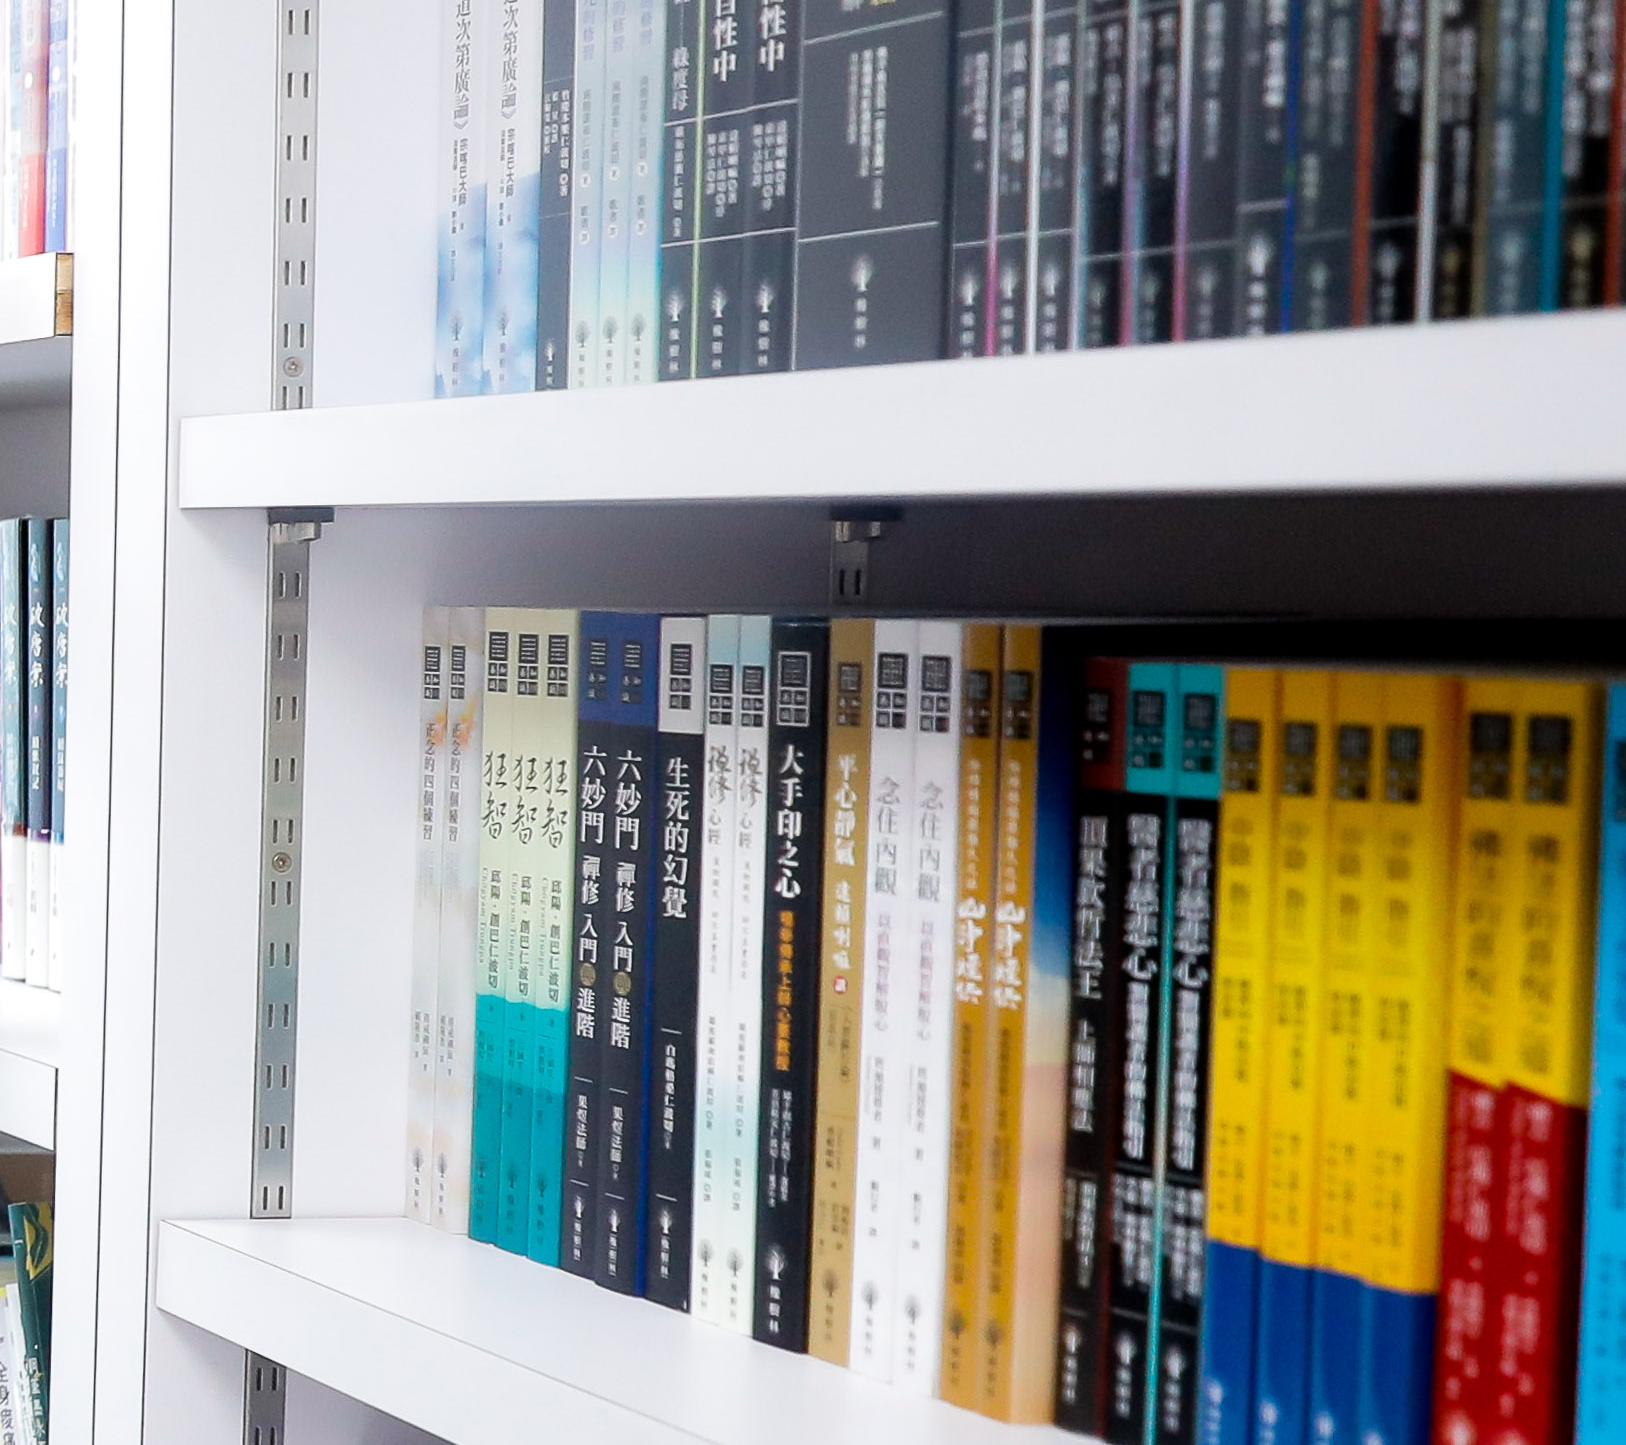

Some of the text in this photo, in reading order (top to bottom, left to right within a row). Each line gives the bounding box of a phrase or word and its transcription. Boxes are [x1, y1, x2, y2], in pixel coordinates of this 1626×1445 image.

[481, 749, 509, 841] 狂智
[511, 753, 539, 846] 狂智
[541, 755, 570, 849] 狂智
[578, 744, 609, 845] 六妙門
[613, 749, 643, 852] 六妙門
[661, 756, 691, 920] 生死的幻覺
[773, 743, 805, 899] 大手印之心
[919, 779, 944, 902] 念住內觀
